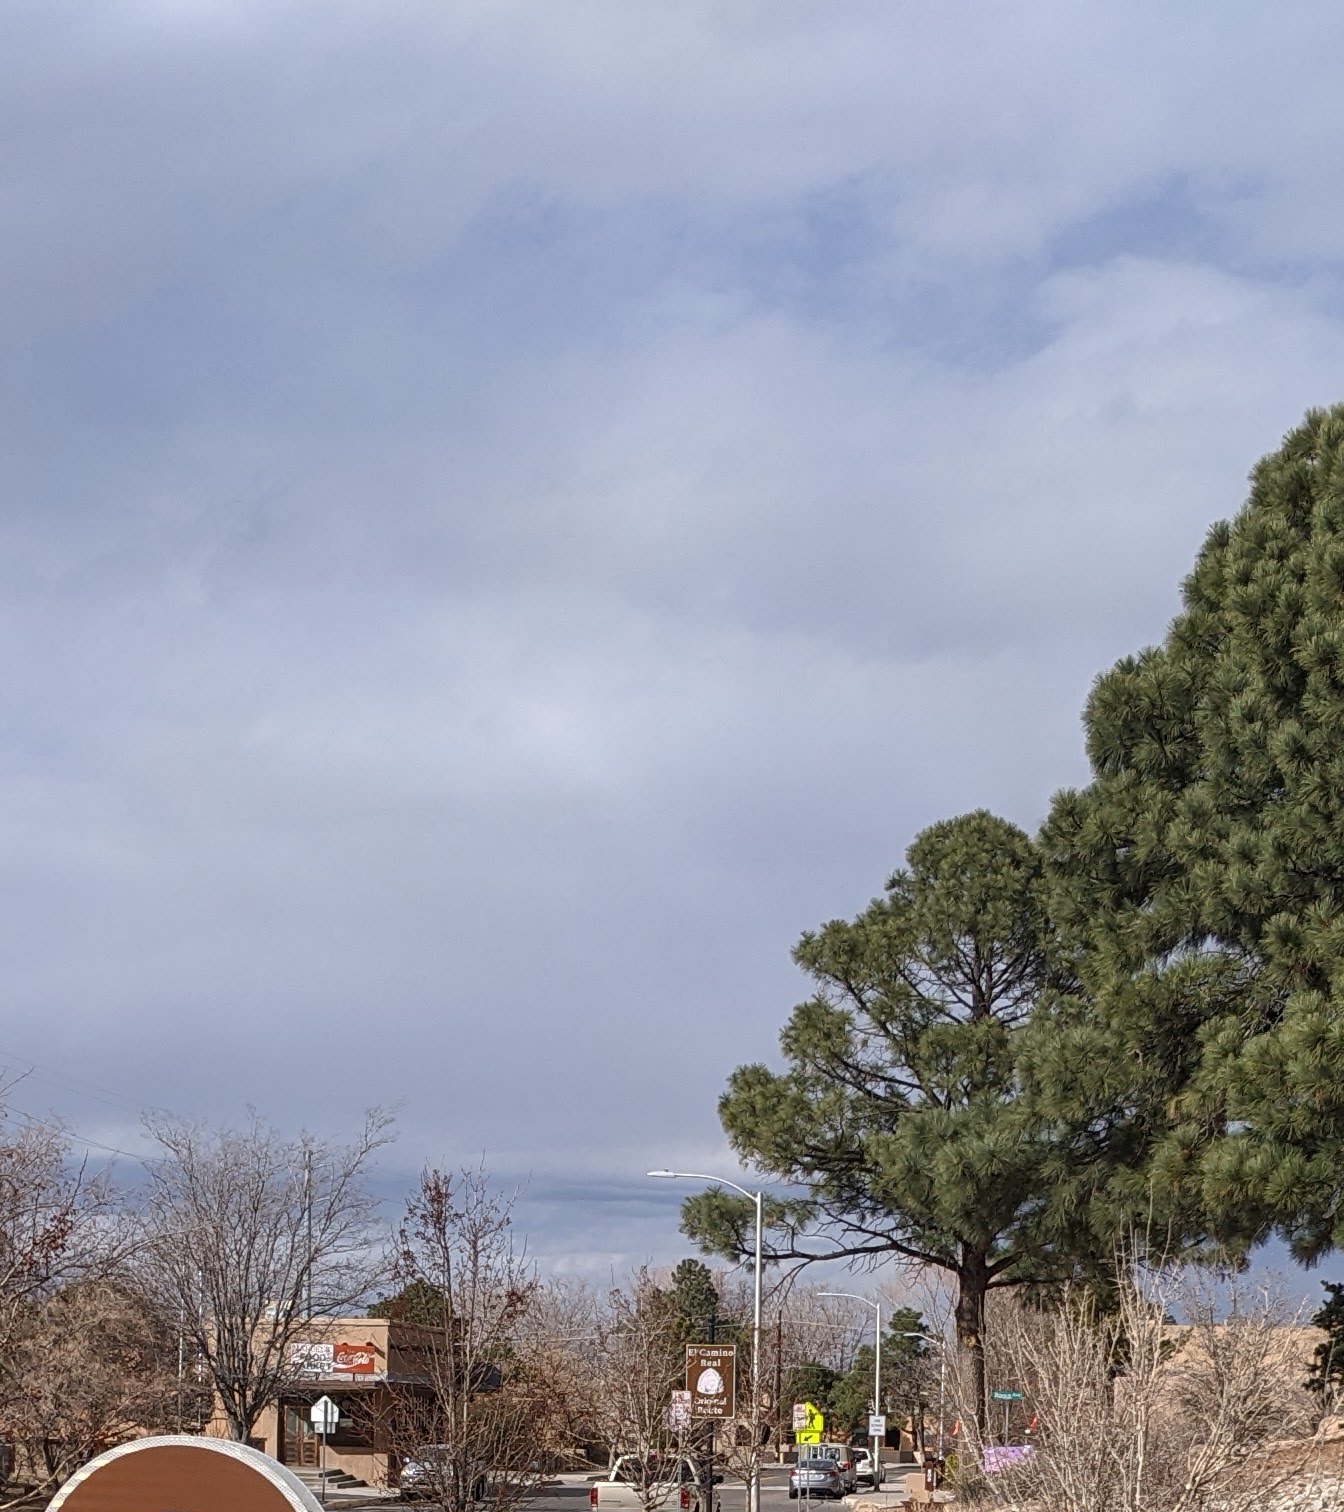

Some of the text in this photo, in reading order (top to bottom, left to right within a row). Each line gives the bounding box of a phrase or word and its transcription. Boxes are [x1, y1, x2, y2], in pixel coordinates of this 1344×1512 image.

[688, 1348, 734, 1357] El Camino
[700, 1358, 721, 1367] Real
